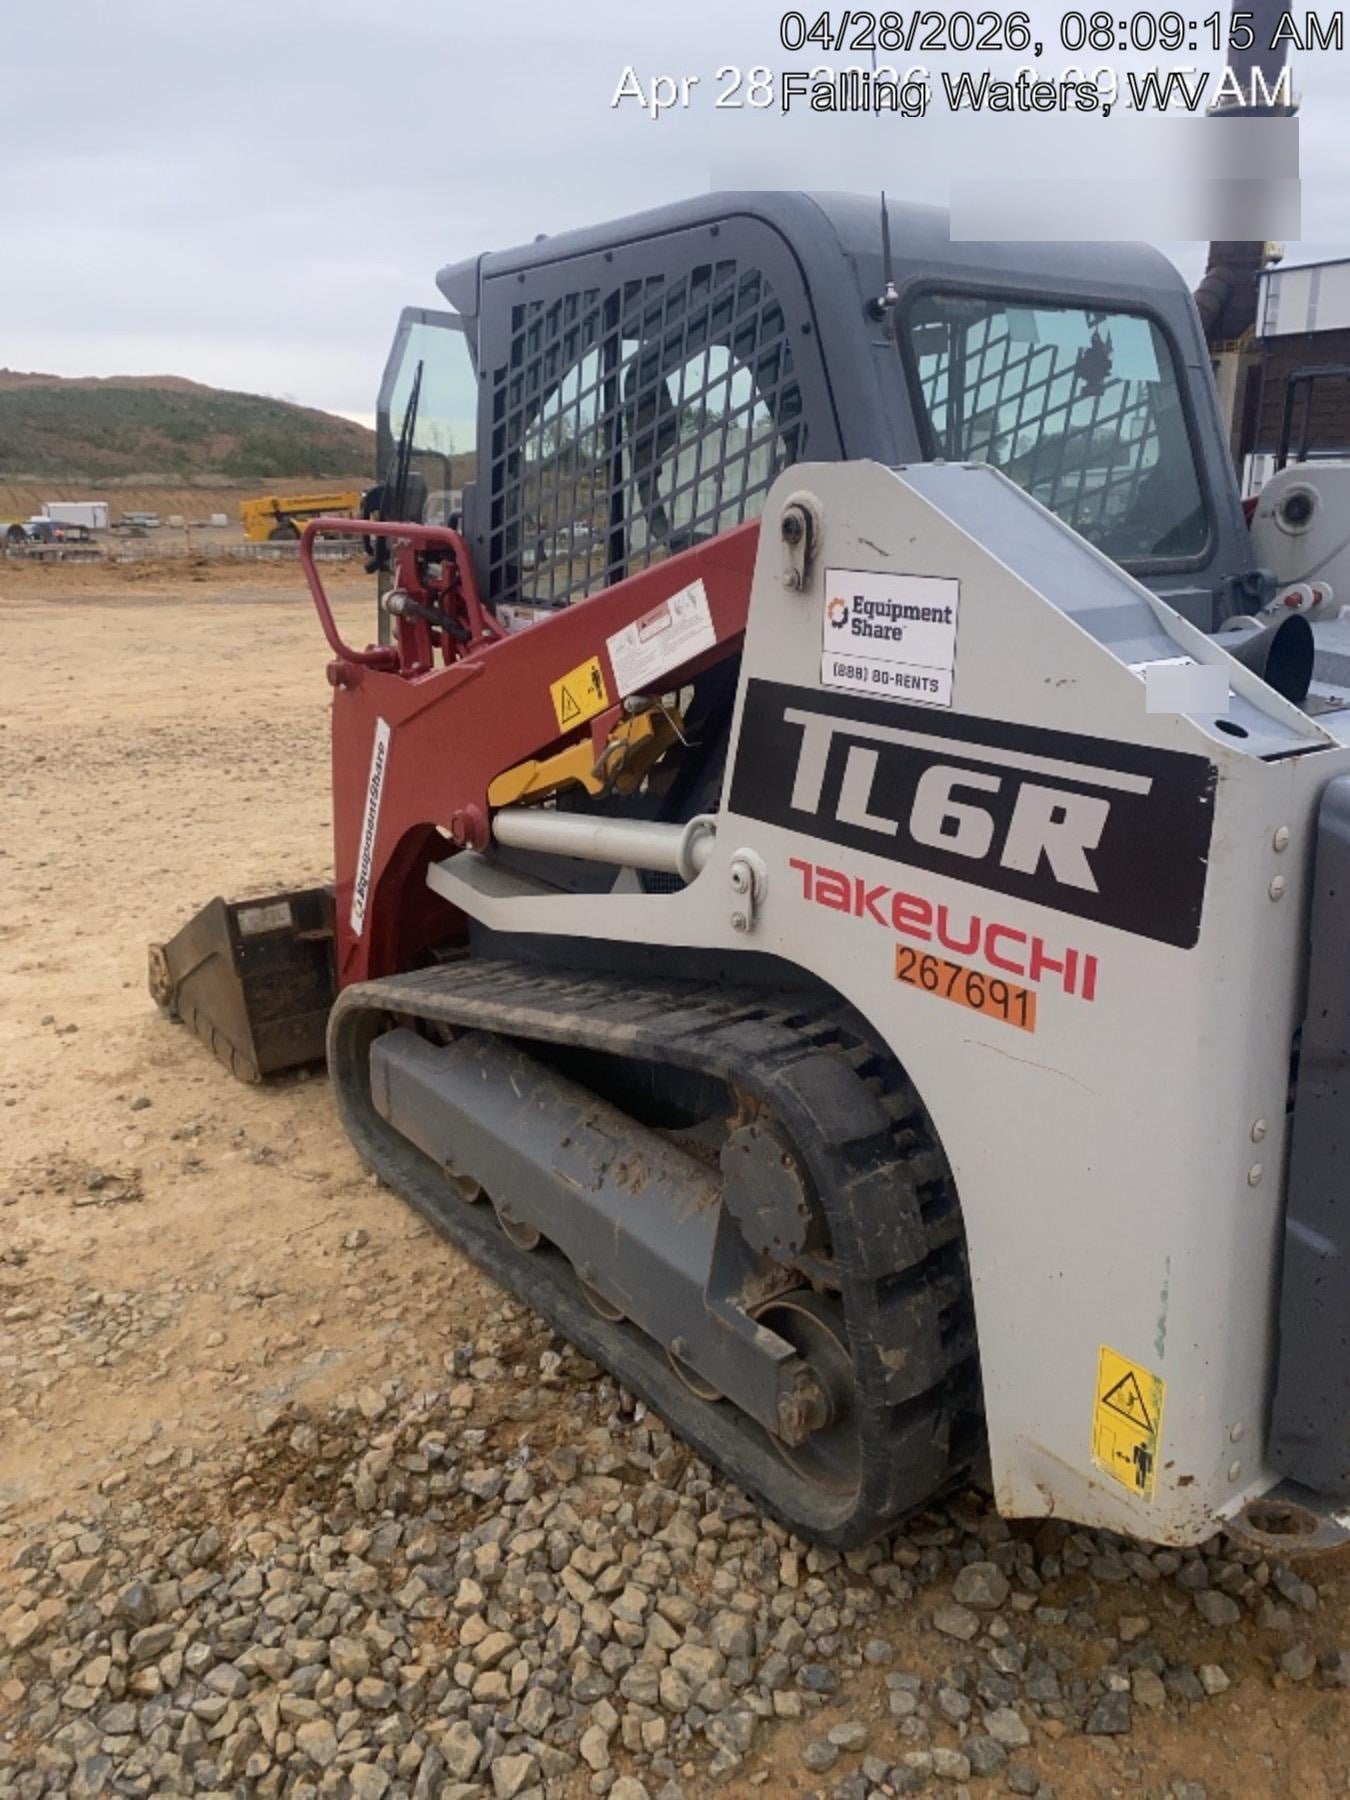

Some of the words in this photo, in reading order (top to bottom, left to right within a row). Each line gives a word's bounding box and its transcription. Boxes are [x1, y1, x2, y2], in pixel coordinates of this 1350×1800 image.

[851, 595, 953, 624] Equipment
[851, 618, 903, 641] Share
[833, 662, 869, 682] (888)
[871, 669, 939, 693] 80-RENTS
[783, 707, 1154, 894] TL6R
[897, 946, 1032, 1028] 267691
